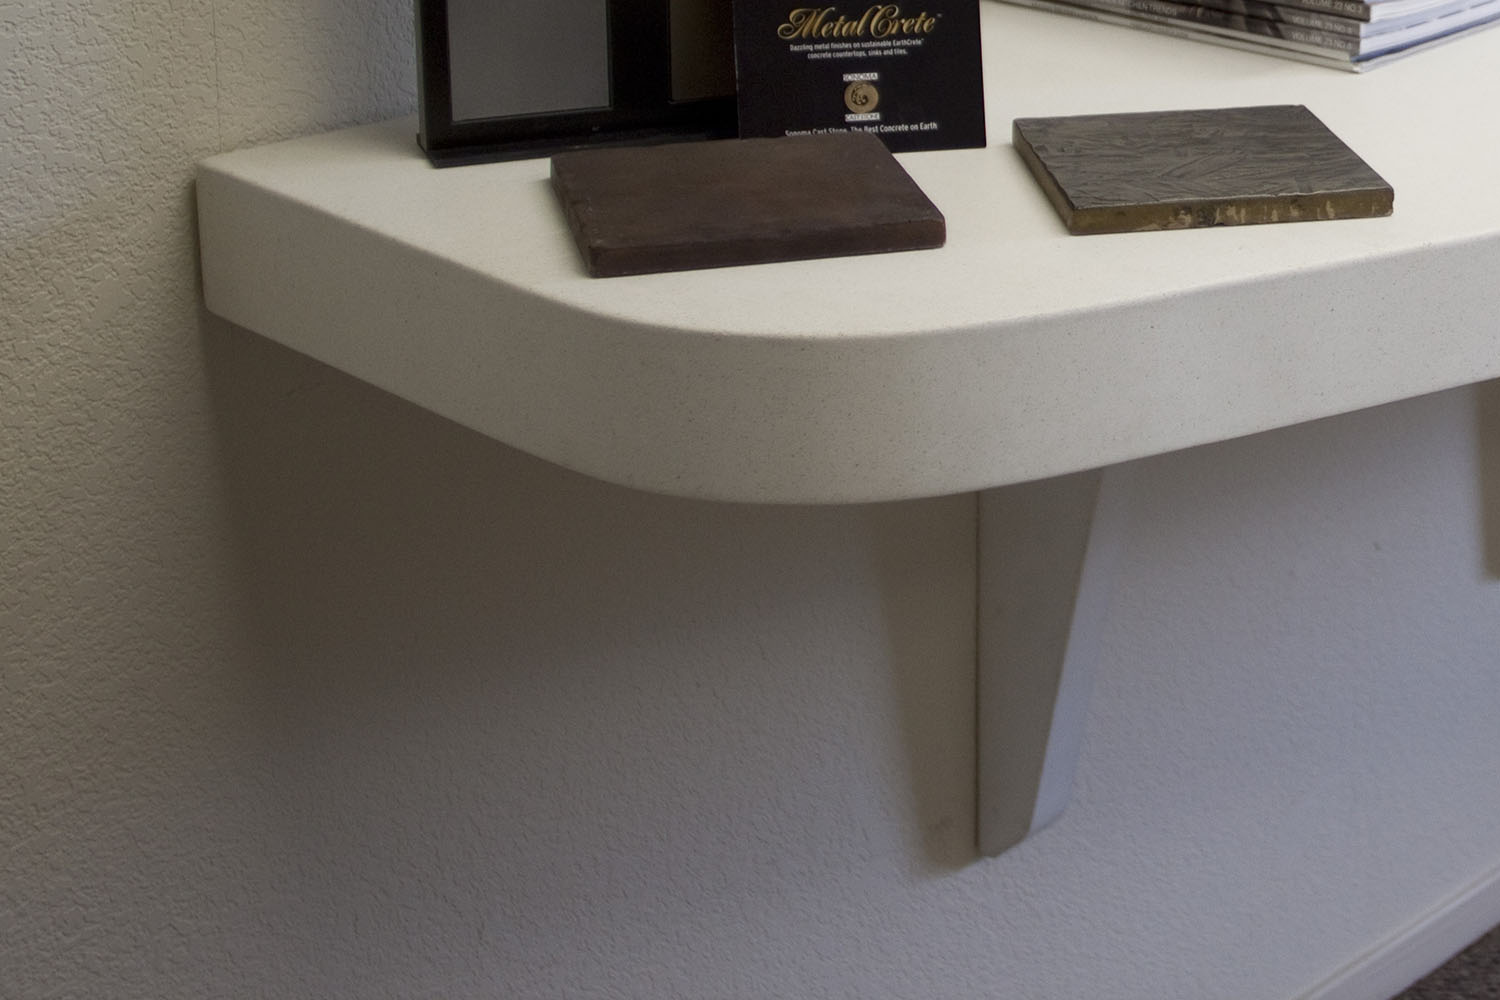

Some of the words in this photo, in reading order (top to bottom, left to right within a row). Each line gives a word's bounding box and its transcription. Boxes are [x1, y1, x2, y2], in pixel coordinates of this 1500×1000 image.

[1147, 2, 1177, 17] TRENDS
[1344, 2, 1356, 13] NO
[1292, 15, 1322, 29] VOLUME
[1292, 30, 1322, 45] VOLUME
[790, 43, 813, 52] Dazzling
[814, 42, 830, 50] metal
[830, 41, 852, 50] finishes
[861, 40, 892, 48] sustainable
[808, 52, 832, 60] concrete
[883, 48, 893, 56] and
[880, 124, 908, 133] Concrete
[920, 122, 938, 130] Earth
